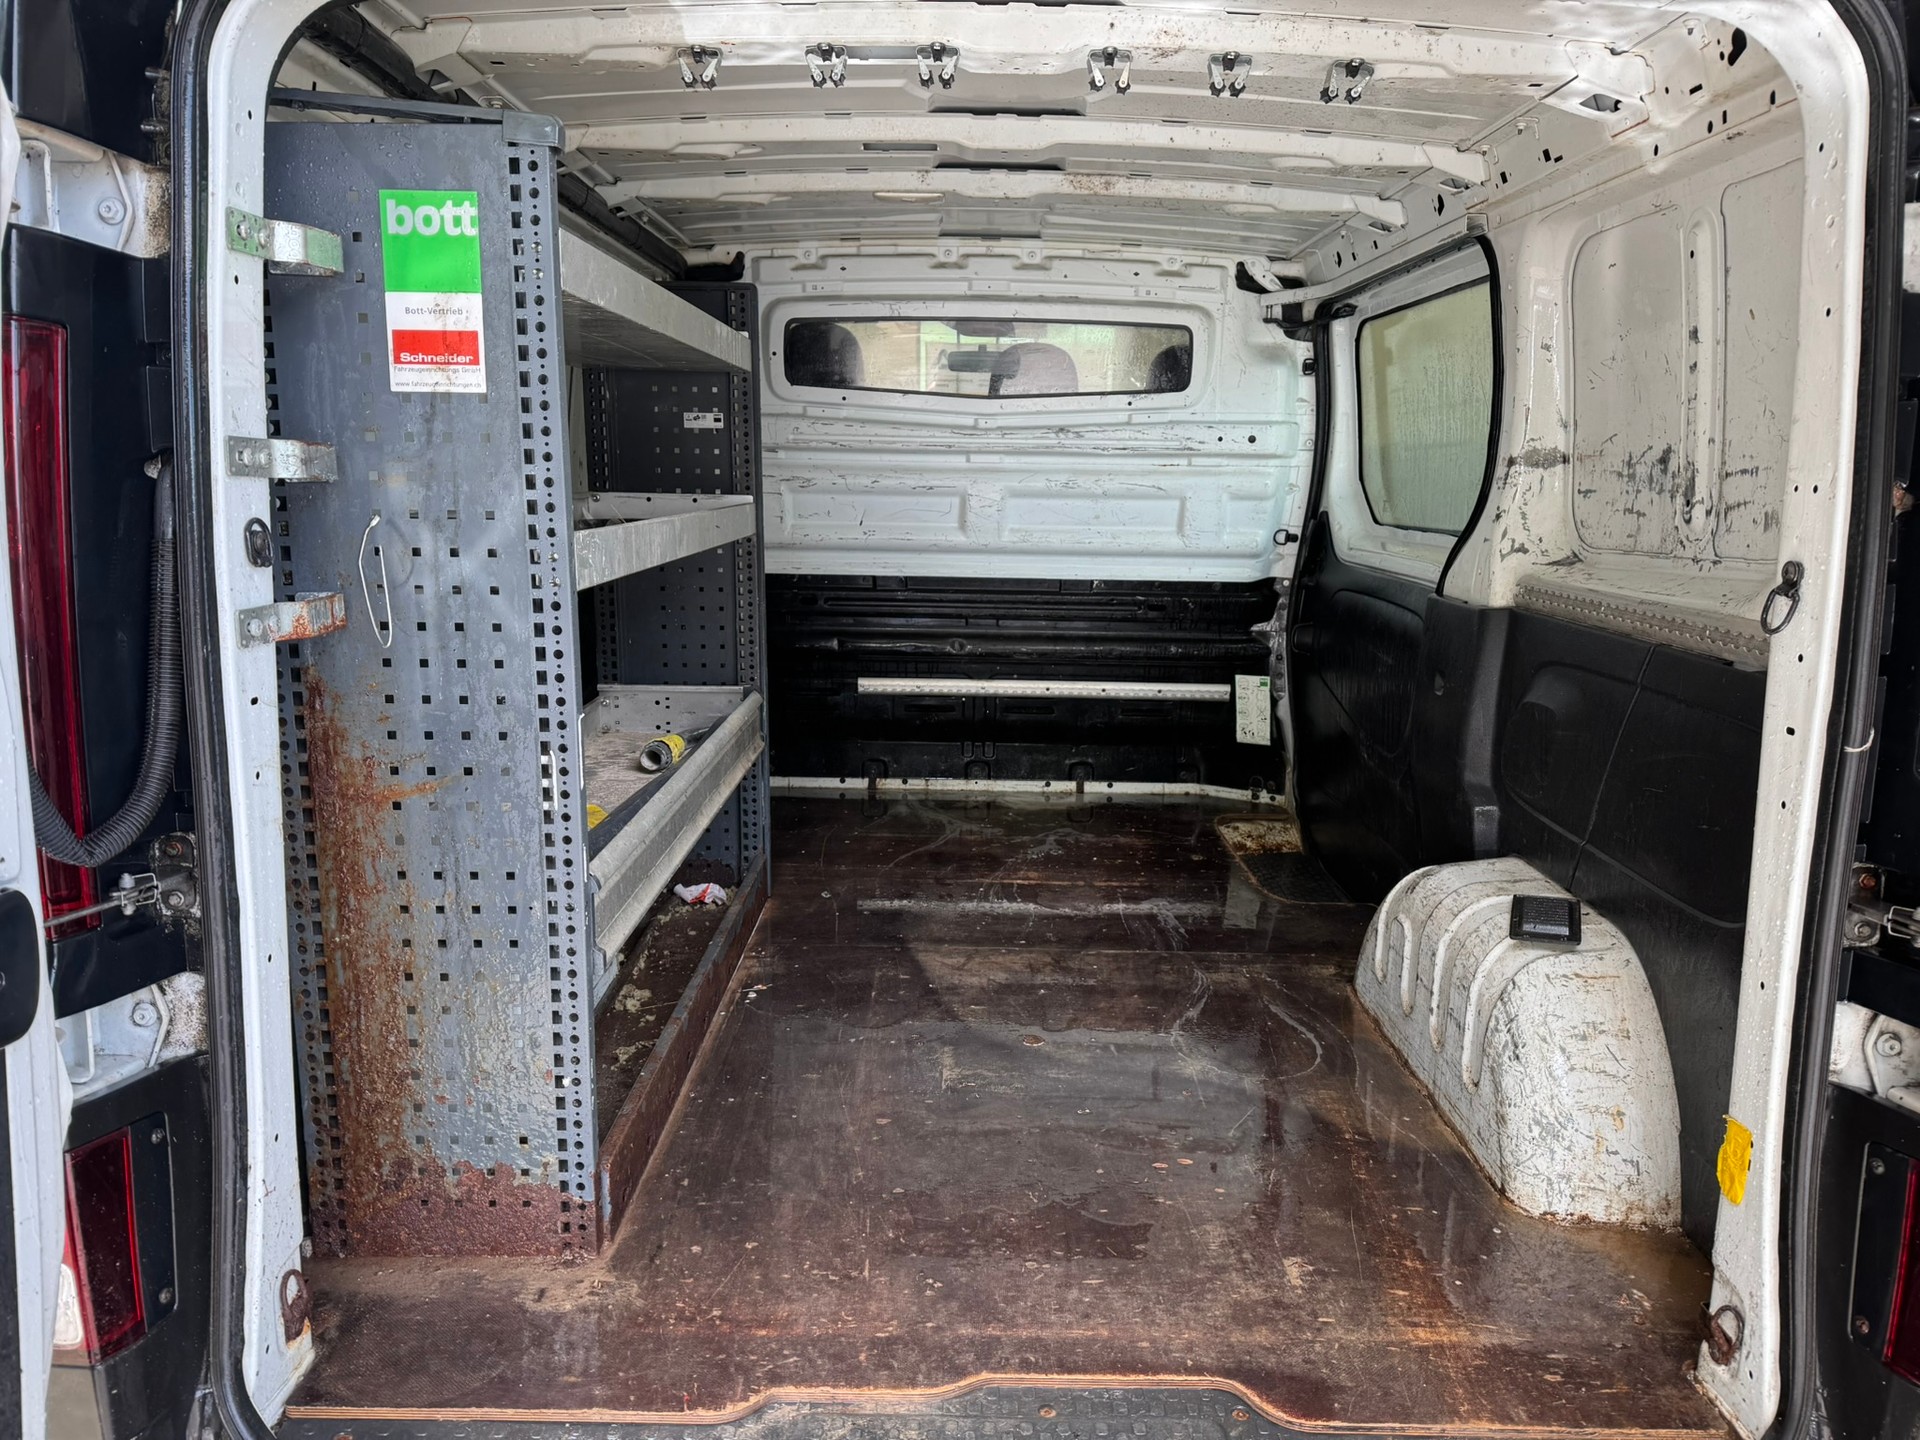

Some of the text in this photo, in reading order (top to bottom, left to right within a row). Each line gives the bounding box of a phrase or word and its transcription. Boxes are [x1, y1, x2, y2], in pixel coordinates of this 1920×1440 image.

[387, 199, 478, 236] bott
[405, 307, 463, 315] Bott-Vertrieb
[400, 353, 473, 363] Schneider
[394, 366, 459, 374] Fahrzeugeinrichtungs
